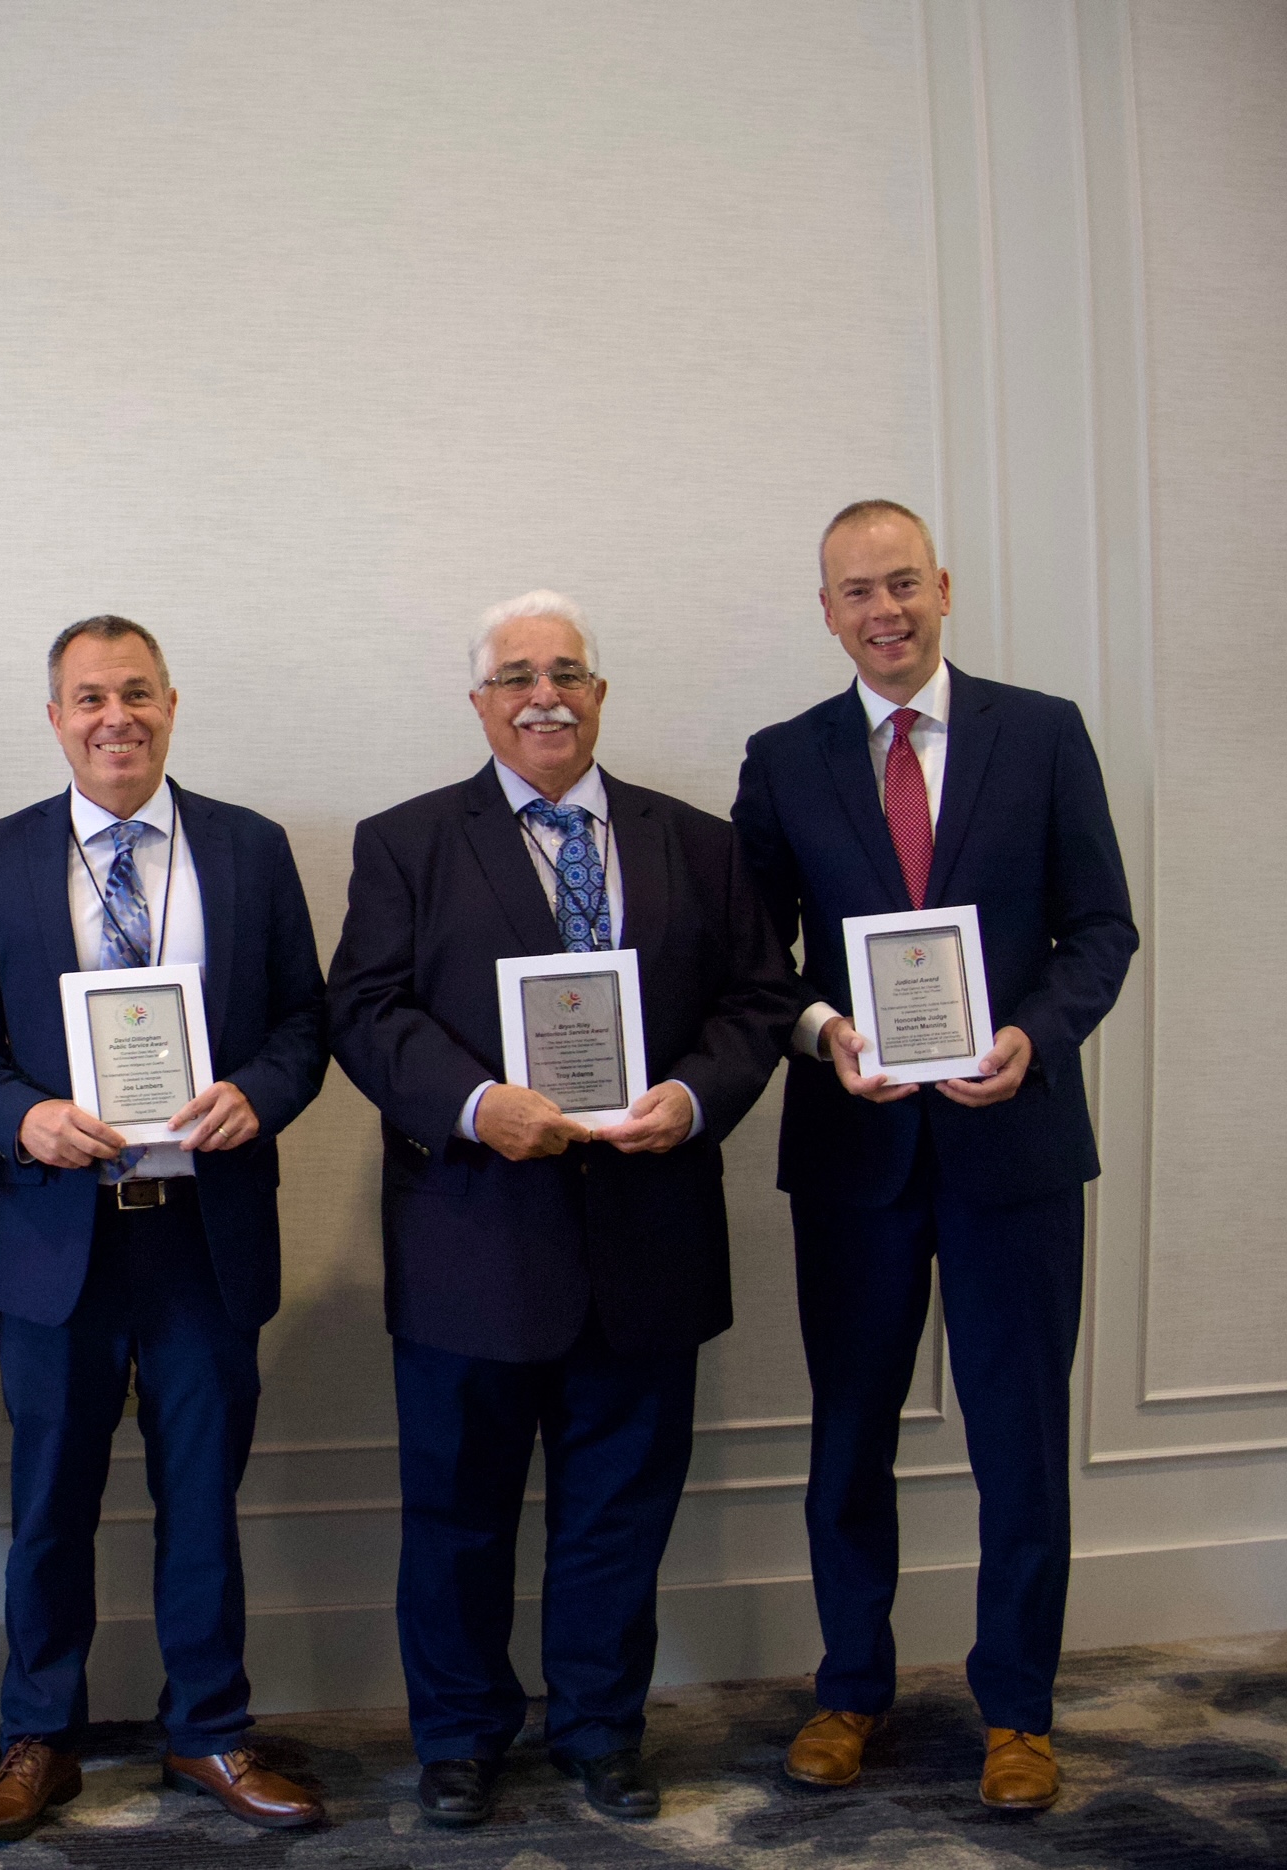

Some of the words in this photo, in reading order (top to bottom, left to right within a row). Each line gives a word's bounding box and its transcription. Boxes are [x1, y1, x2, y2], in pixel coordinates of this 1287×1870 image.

[895, 977, 919, 986] Judicial
[894, 1016, 927, 1024] Honorable
[896, 1024, 919, 1032] Nathan
[920, 1022, 947, 1030] Manning
